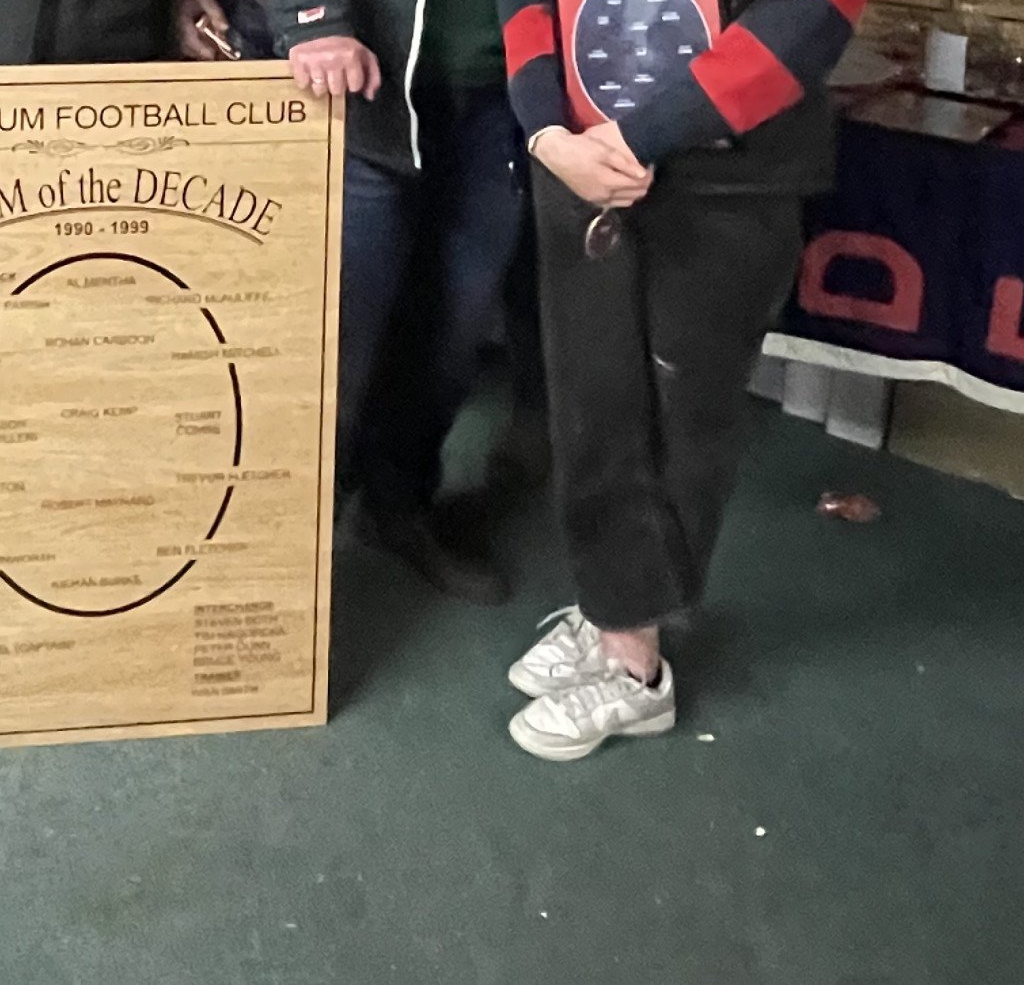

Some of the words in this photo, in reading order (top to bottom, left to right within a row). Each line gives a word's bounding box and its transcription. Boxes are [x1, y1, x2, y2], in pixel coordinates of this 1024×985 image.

[56, 102, 217, 131] FOOTBALL
[226, 100, 307, 126] CLUB
[38, 169, 72, 208] of
[78, 167, 121, 204] the
[134, 168, 282, 238] DECADE
[54, 221, 94, 236] 1990
[111, 220, 150, 235] 1999
